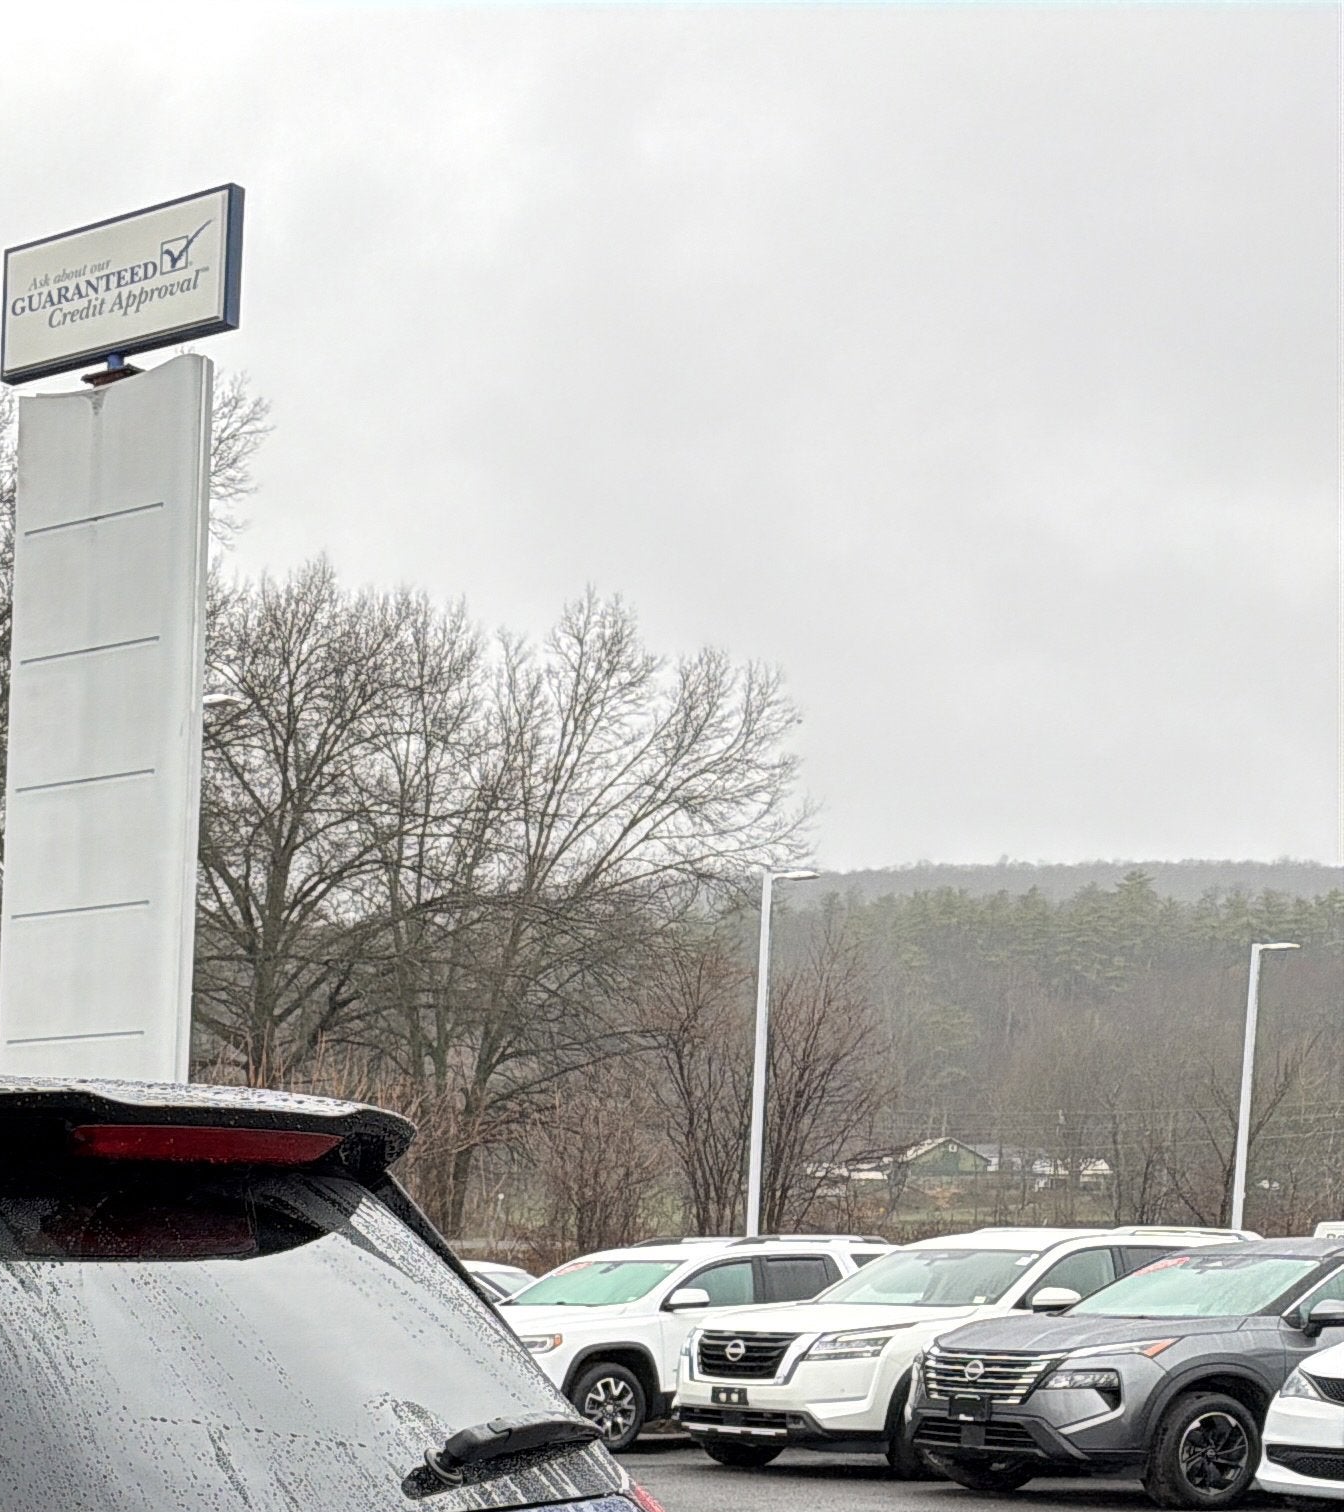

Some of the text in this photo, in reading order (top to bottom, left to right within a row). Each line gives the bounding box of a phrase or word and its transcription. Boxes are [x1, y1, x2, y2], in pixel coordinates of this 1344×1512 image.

[12, 261, 158, 316] GUARANTEED
[28, 259, 112, 292] Ask about our
[48, 270, 200, 329] Credit Approval
